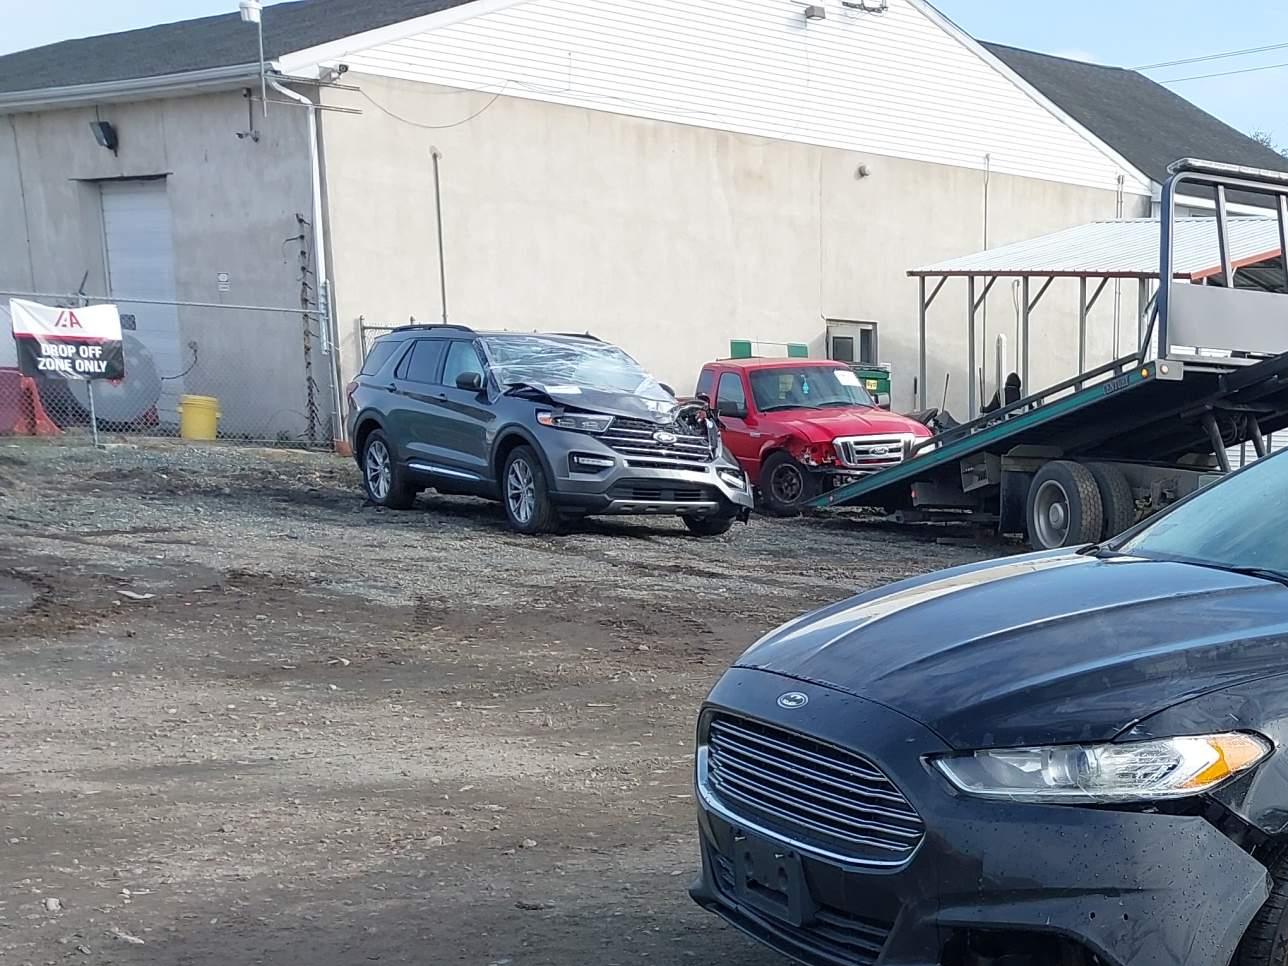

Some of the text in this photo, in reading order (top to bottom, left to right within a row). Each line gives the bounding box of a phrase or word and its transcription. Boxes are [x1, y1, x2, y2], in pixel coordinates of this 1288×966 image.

[41, 344, 103, 358] DROP OFF
[38, 357, 108, 373] ZONE ONLY
